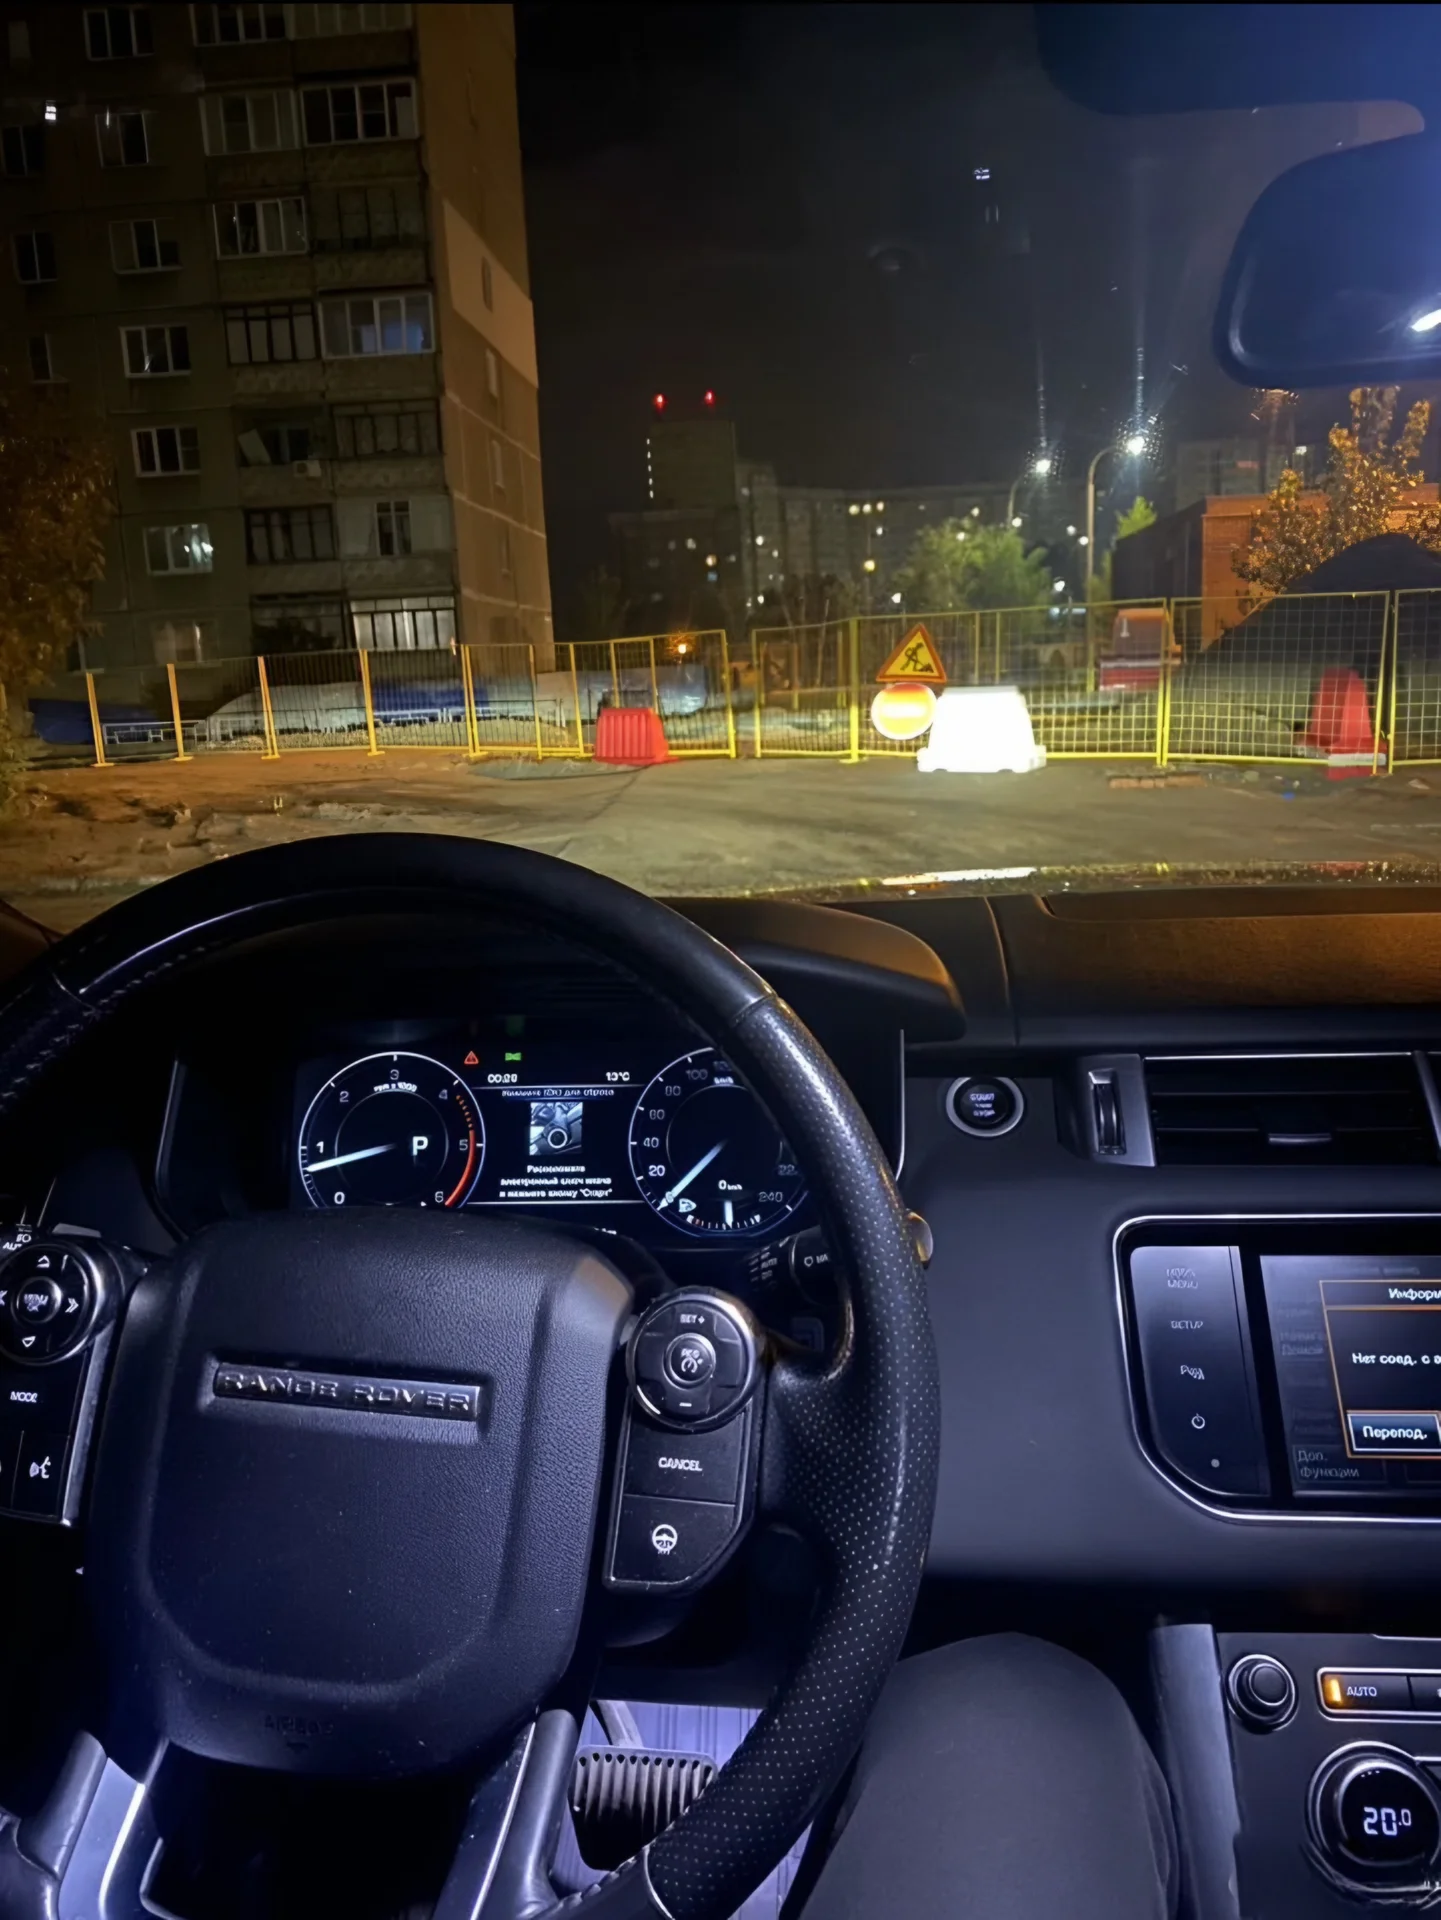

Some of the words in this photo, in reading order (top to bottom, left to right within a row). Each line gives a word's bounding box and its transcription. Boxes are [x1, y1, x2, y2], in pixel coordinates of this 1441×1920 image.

[390, 1069, 399, 1080] 3
[685, 1069, 708, 1080] 100
[339, 1090, 349, 1103] 2
[438, 1089, 448, 1100] 4
[316, 1141, 325, 1153] 1
[412, 1136, 428, 1156] P
[459, 1139, 468, 1151] 5
[643, 1137, 659, 1148] 40
[649, 1165, 665, 1176] 20
[718, 1180, 727, 1190] 0
[334, 1191, 345, 1204] 0
[434, 1191, 444, 1203] 6
[758, 1191, 783, 1202] 240
[1170, 1320, 1204, 1329] SETUP
[1352, 1353, 1376, 1364] Нет
[224, 1372, 339, 1398] RANGE
[353, 1383, 469, 1411] ROVER
[658, 1456, 703, 1472] CANCEL
[1346, 1686, 1378, 1697] AUTO
[1362, 1806, 1412, 1836] 20.0
